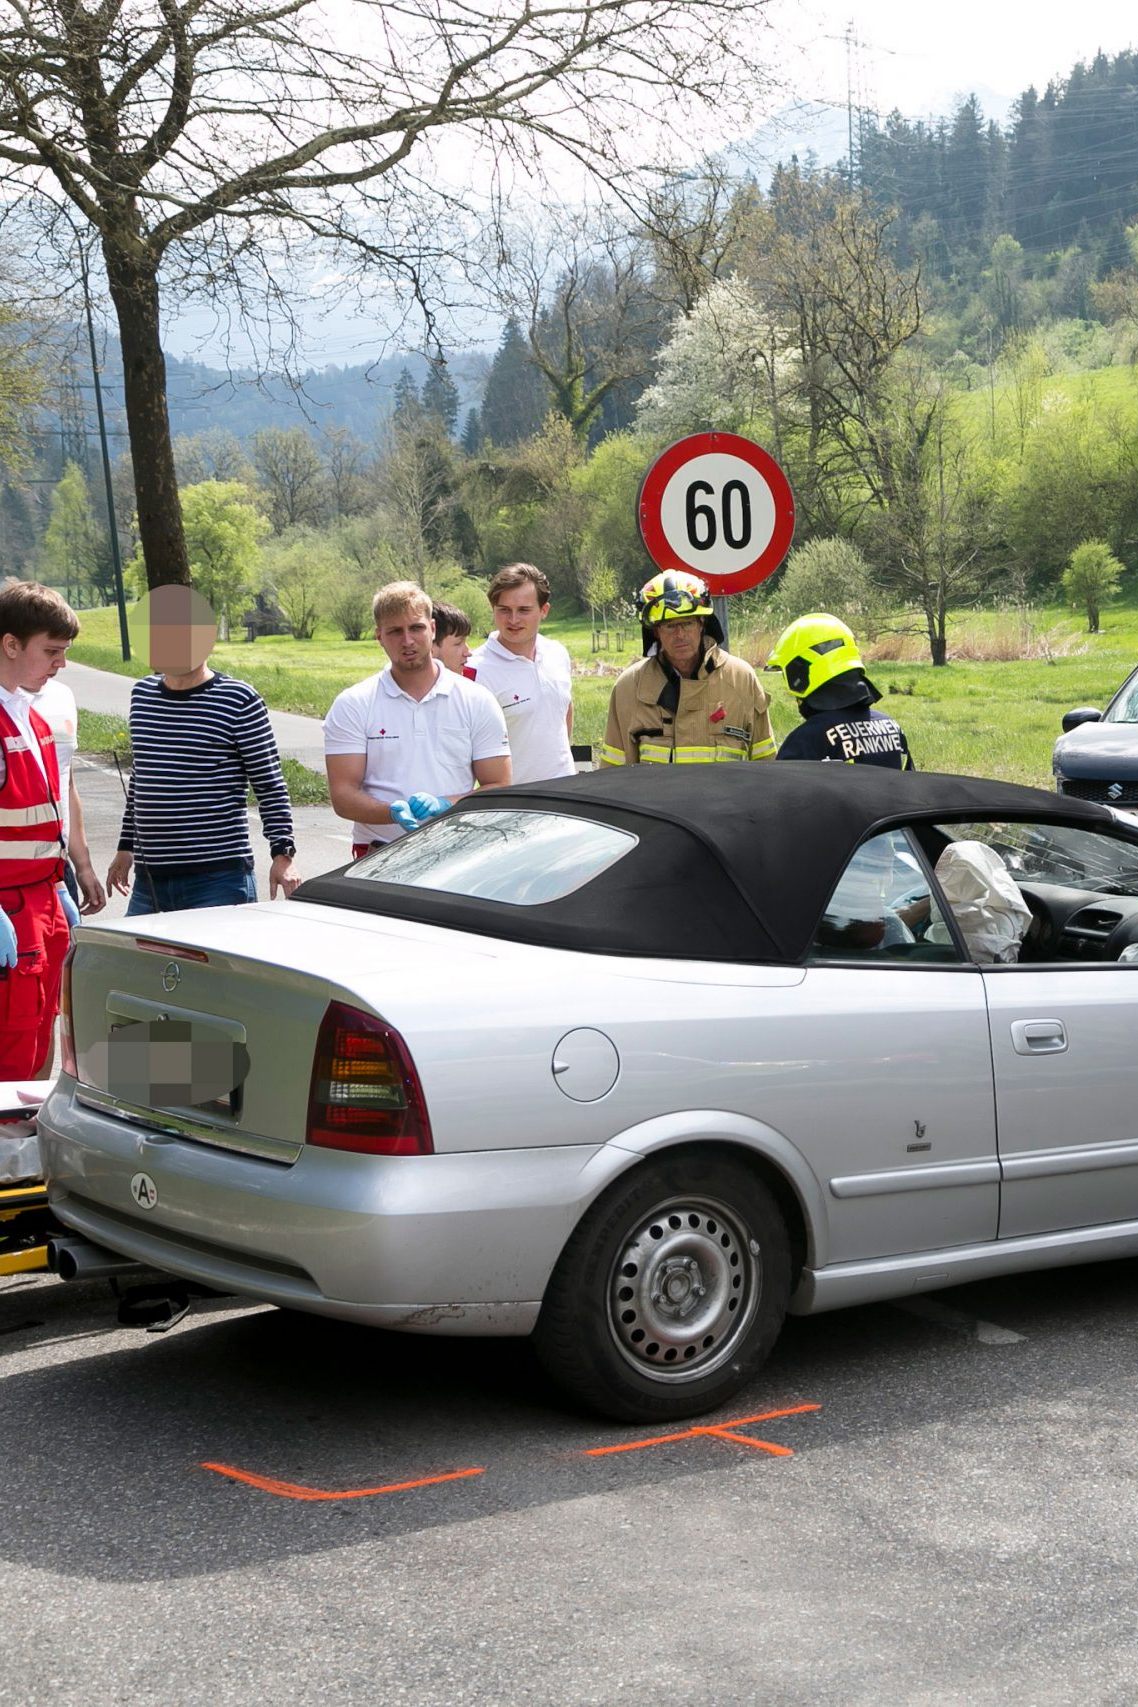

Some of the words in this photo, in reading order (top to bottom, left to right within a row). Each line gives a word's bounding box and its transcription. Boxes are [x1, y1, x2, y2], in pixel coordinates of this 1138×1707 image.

[686, 480, 752, 551] 60
[826, 719, 904, 746] FEUERWEH
[842, 734, 904, 759] RANKWE
[138, 1178, 151, 1204] A
